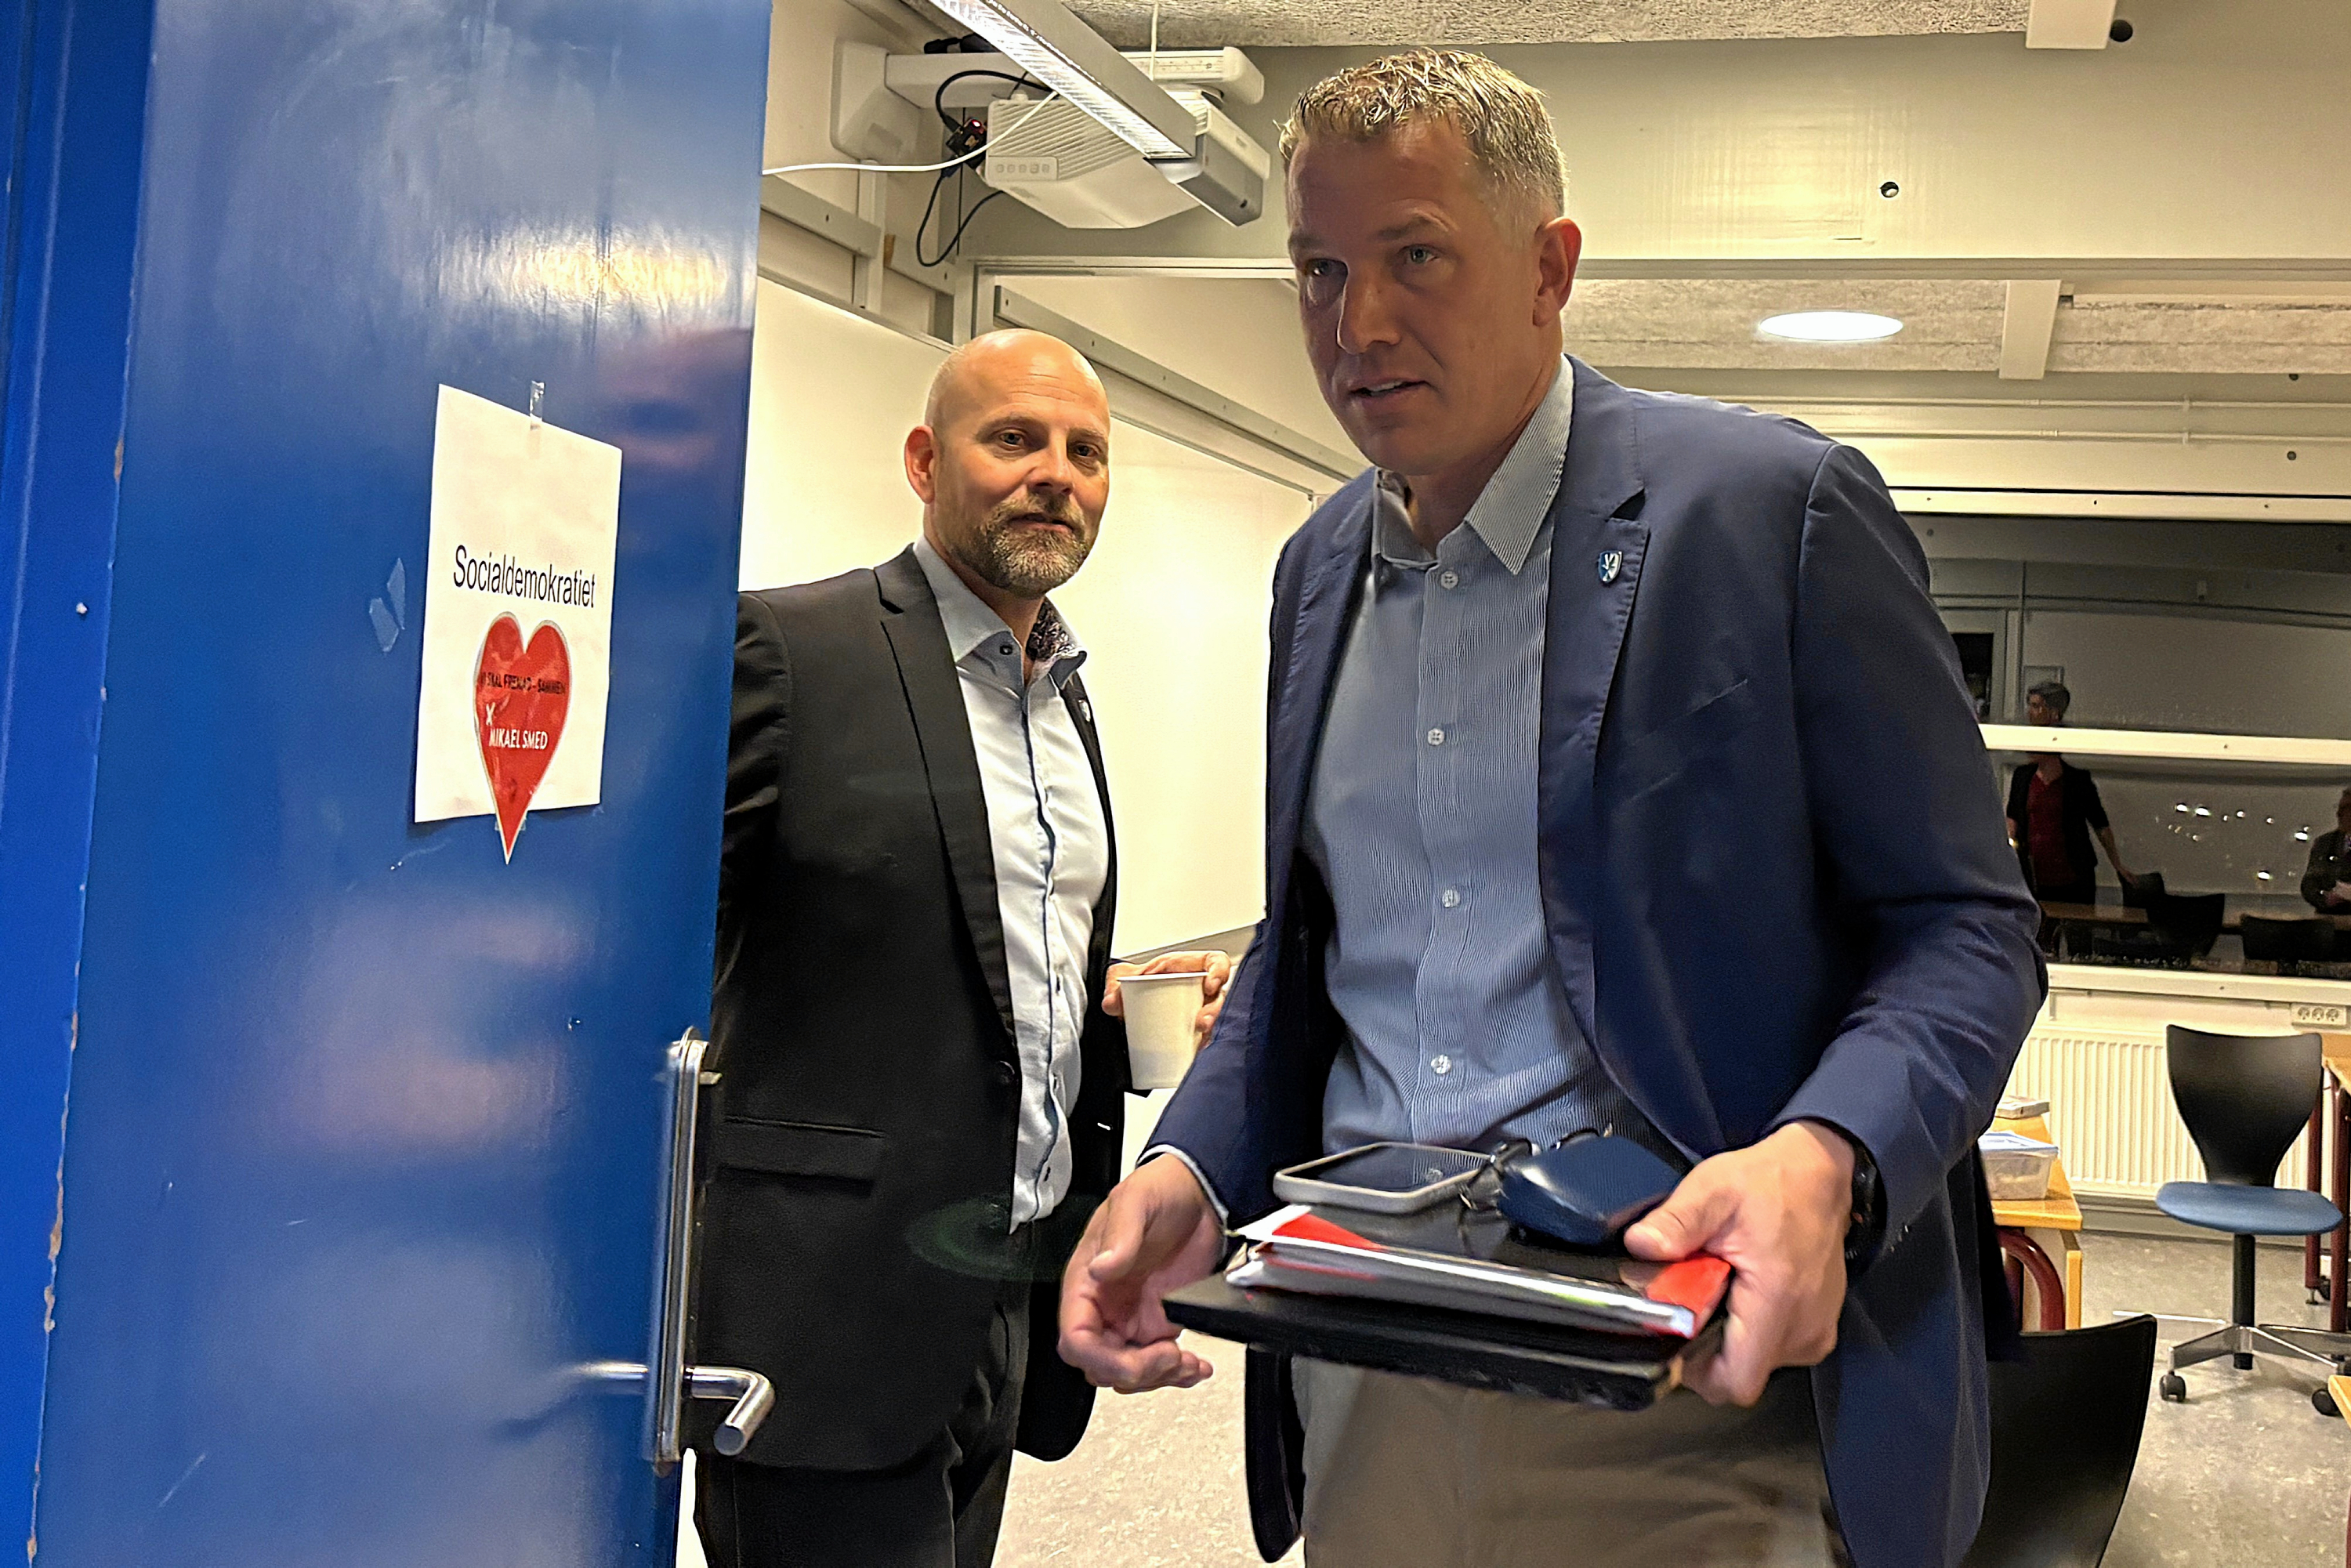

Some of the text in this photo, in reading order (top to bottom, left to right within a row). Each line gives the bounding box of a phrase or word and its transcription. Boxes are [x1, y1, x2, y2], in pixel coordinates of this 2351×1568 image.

[454, 545, 595, 607] Socialdemokratiet
[489, 729, 548, 750] MIKAEL SMED
